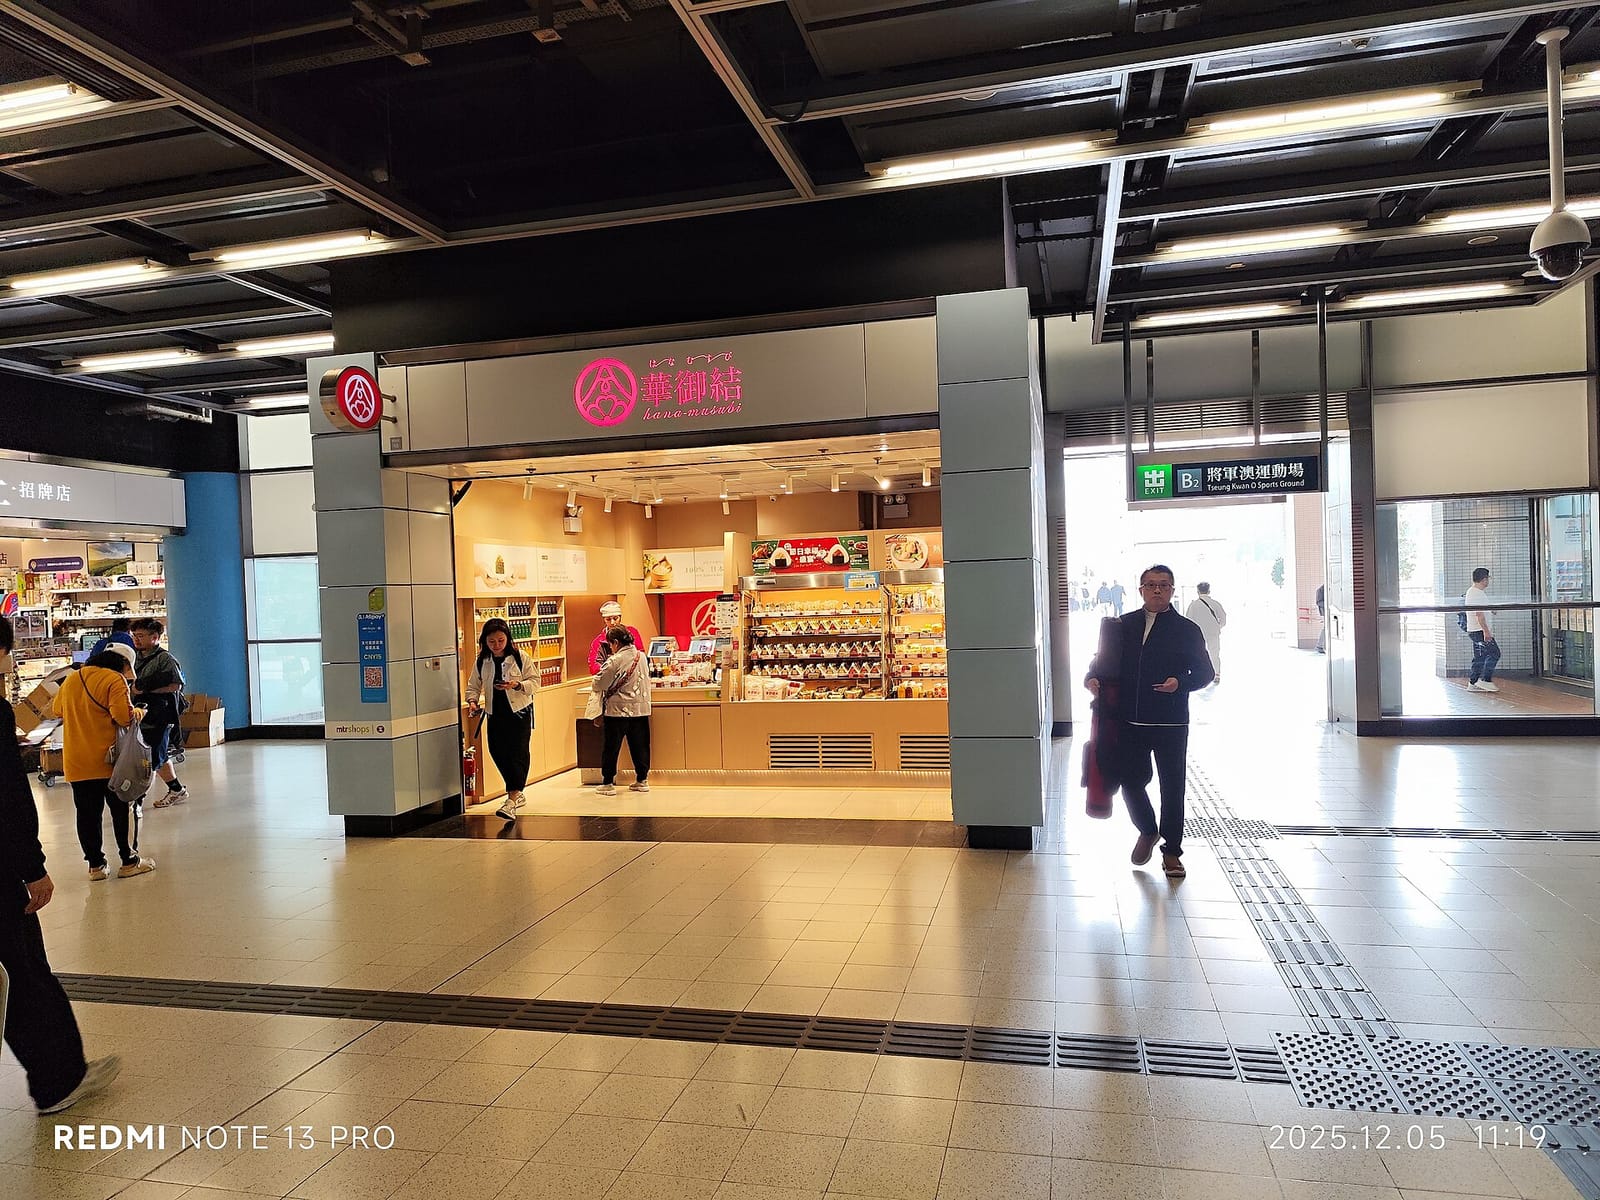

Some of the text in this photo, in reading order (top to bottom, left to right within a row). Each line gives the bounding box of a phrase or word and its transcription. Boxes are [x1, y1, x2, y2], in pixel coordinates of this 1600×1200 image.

[640, 366, 743, 408] 華御結
[643, 401, 742, 420] hana-musubi
[1181, 473, 1199, 488] B2
[1207, 462, 1304, 482] 將軍澳運動場
[18, 480, 71, 502] 招牌店
[1144, 487, 1164, 495] EXIT
[1207, 483, 1230, 492] Tseung
[1231, 482, 1250, 490] Kwan
[1257, 480, 1278, 490] Sports
[1279, 479, 1304, 488] Ground
